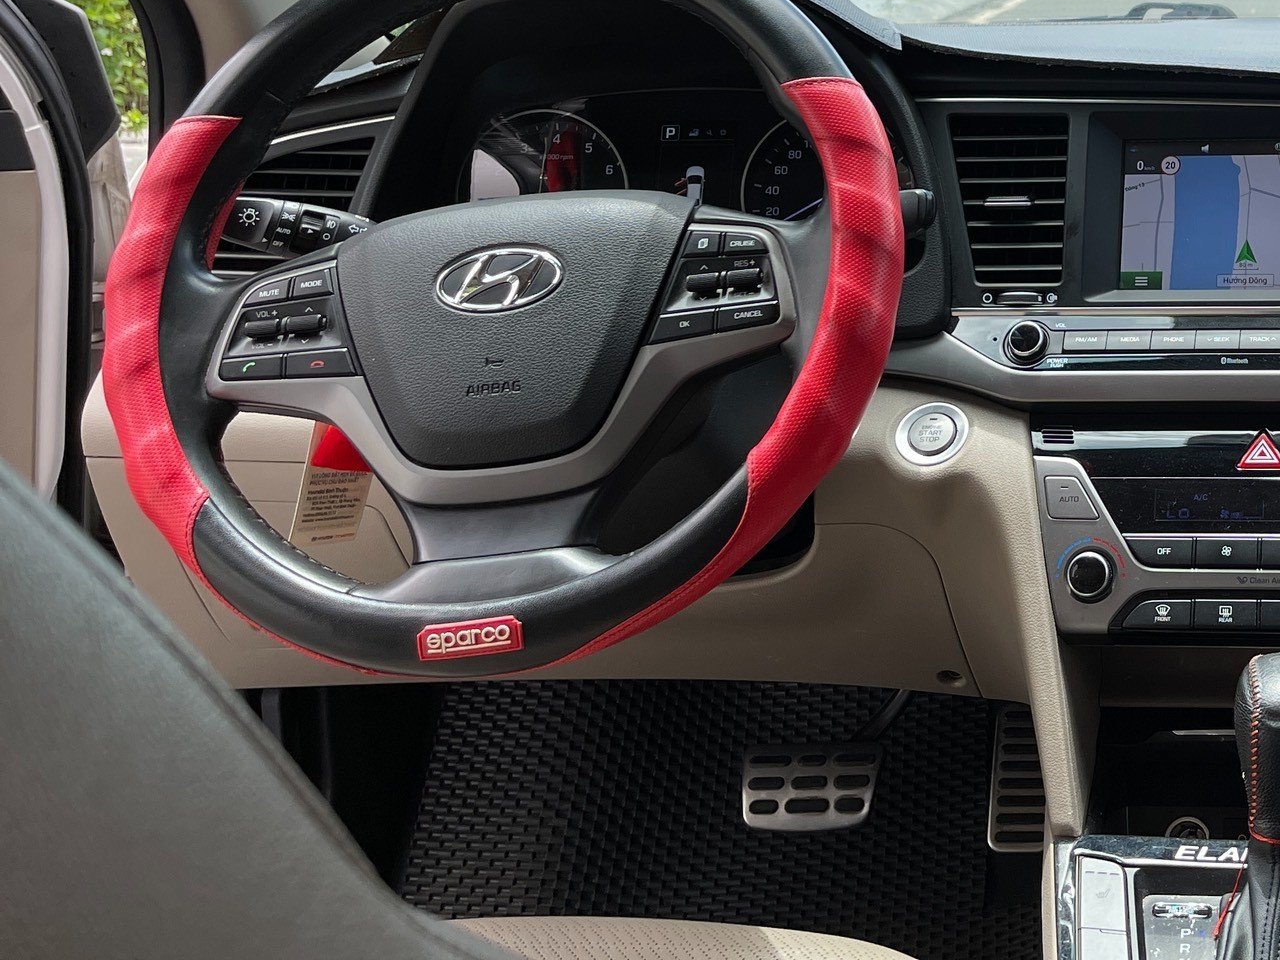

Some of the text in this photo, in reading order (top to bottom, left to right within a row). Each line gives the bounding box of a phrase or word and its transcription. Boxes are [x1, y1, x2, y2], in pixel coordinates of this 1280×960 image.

[665, 127, 676, 139] P
[552, 133, 561, 144] 4
[520, 143, 528, 153] 3
[584, 142, 593, 153] 5
[788, 150, 802, 159] 80
[605, 164, 614, 175] 6
[774, 165, 788, 175] 60
[1136, 160, 1145, 171] 0
[1165, 161, 1176, 170] 20
[765, 185, 780, 195] 40
[765, 206, 780, 216] 20
[276, 227, 291, 235] AUTO
[300, 279, 322, 289] MODE
[258, 288, 280, 298] MUTE
[733, 310, 763, 320] CANCEL
[679, 320, 690, 328] OK
[466, 380, 521, 398] AIRBAG
[1059, 495, 1079, 503] AUTO
[1156, 547, 1172, 555] OFF
[1249, 576, 1270, 584] Clean
[1180, 928, 1191, 939] P
[1179, 943, 1191, 954] R
